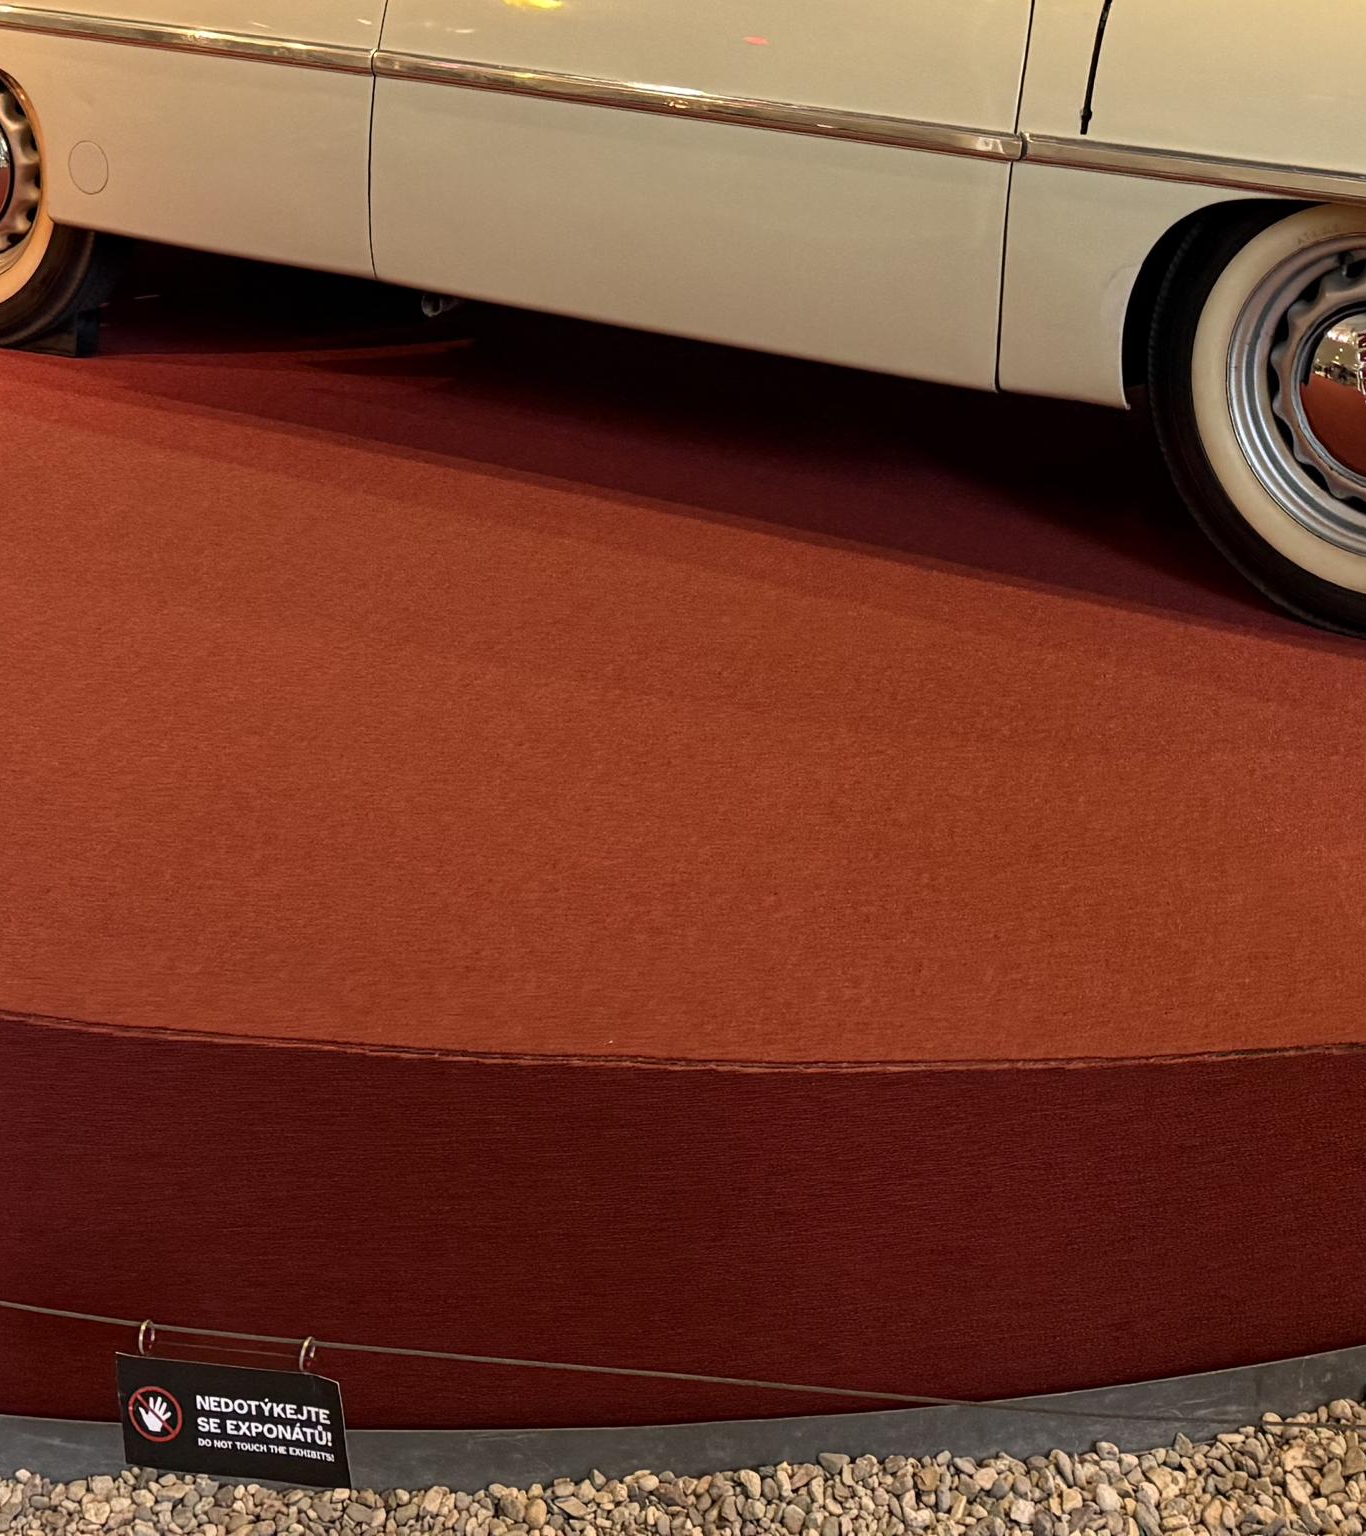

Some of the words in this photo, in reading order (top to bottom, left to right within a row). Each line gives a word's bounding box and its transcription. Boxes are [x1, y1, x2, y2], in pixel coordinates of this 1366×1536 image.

[195, 1394, 331, 1425] NEDOTÝKEJTE
[196, 1417, 221, 1433] SE
[226, 1419, 333, 1447] EXPONÁTŮ!
[197, 1438, 211, 1447] DO
[213, 1440, 233, 1450] NOT
[235, 1441, 267, 1453] TOUCH
[269, 1444, 287, 1455] THE
